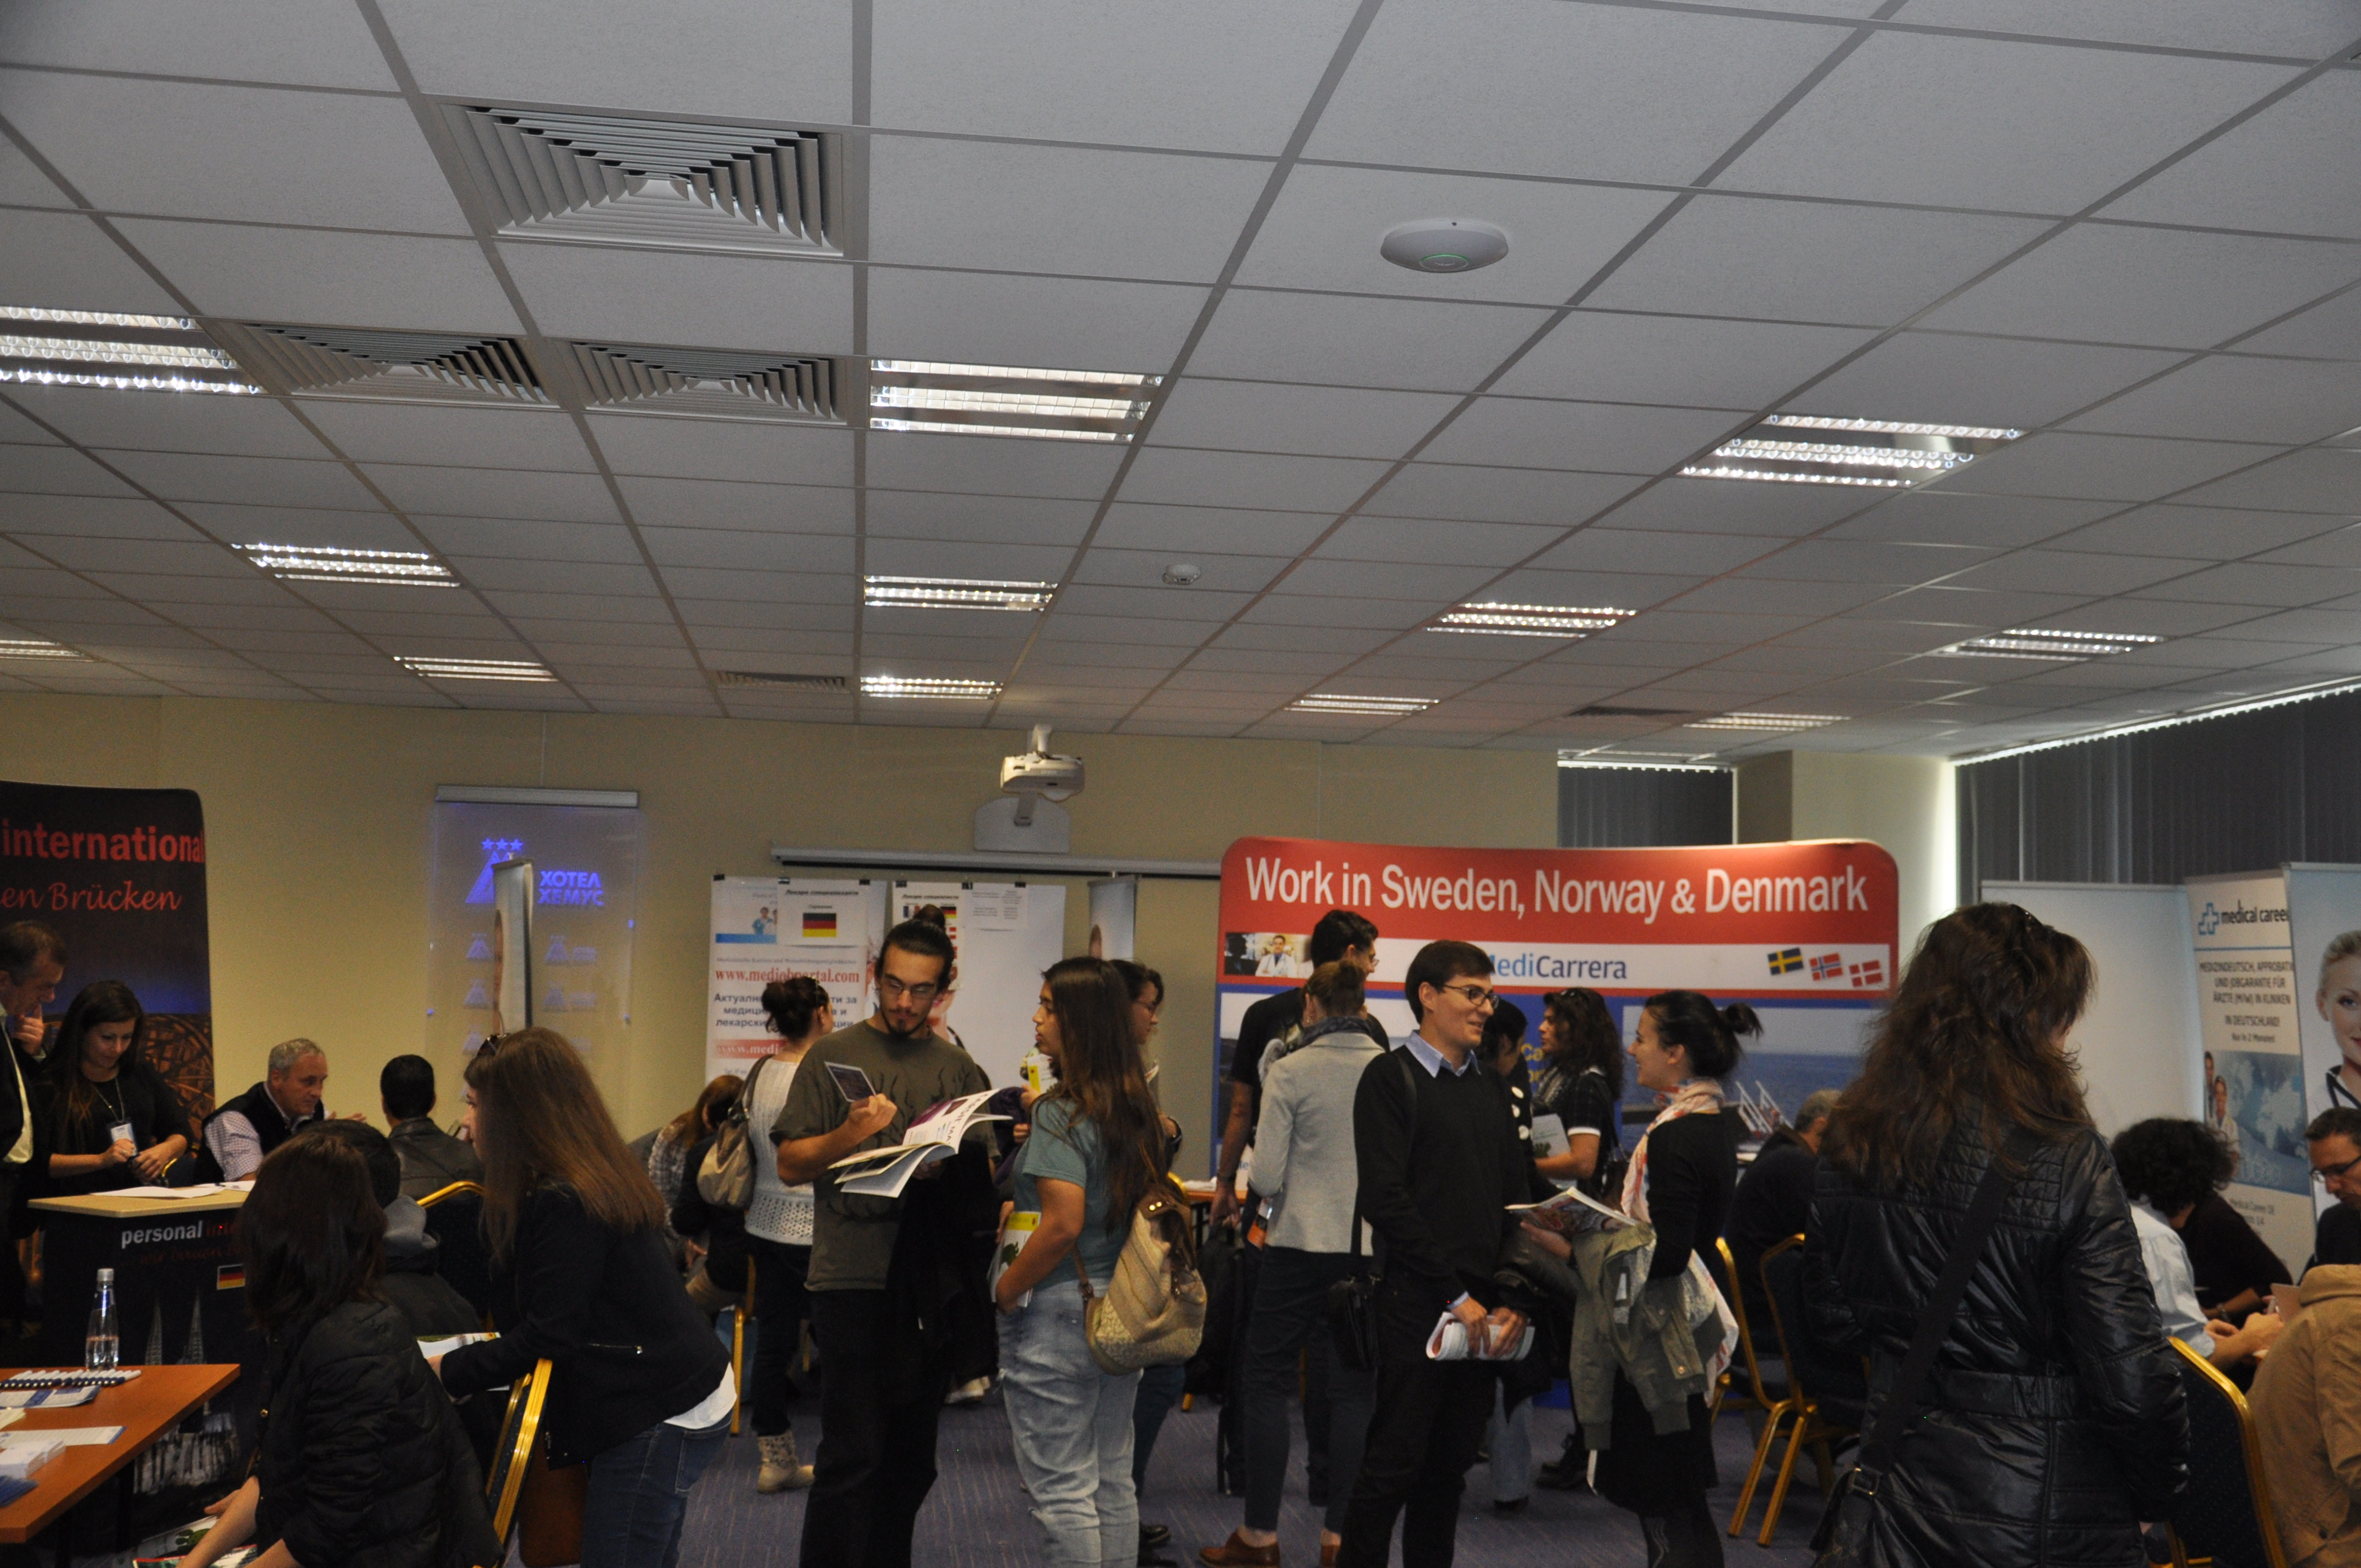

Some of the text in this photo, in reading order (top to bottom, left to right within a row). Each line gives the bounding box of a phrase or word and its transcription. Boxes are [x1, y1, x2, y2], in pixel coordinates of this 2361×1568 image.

[3, 819, 205, 863] international
[540, 870, 601, 888] ХОТЕЛ
[1246, 857, 1868, 924] Work in Sweden, Norway & Denmark
[47, 880, 182, 911] Brücken
[538, 888, 604, 906] ХЕМУС
[2222, 899, 2257, 924] medical
[1490, 954, 1626, 979] ediCarrera
[121, 1220, 204, 1250] personal
